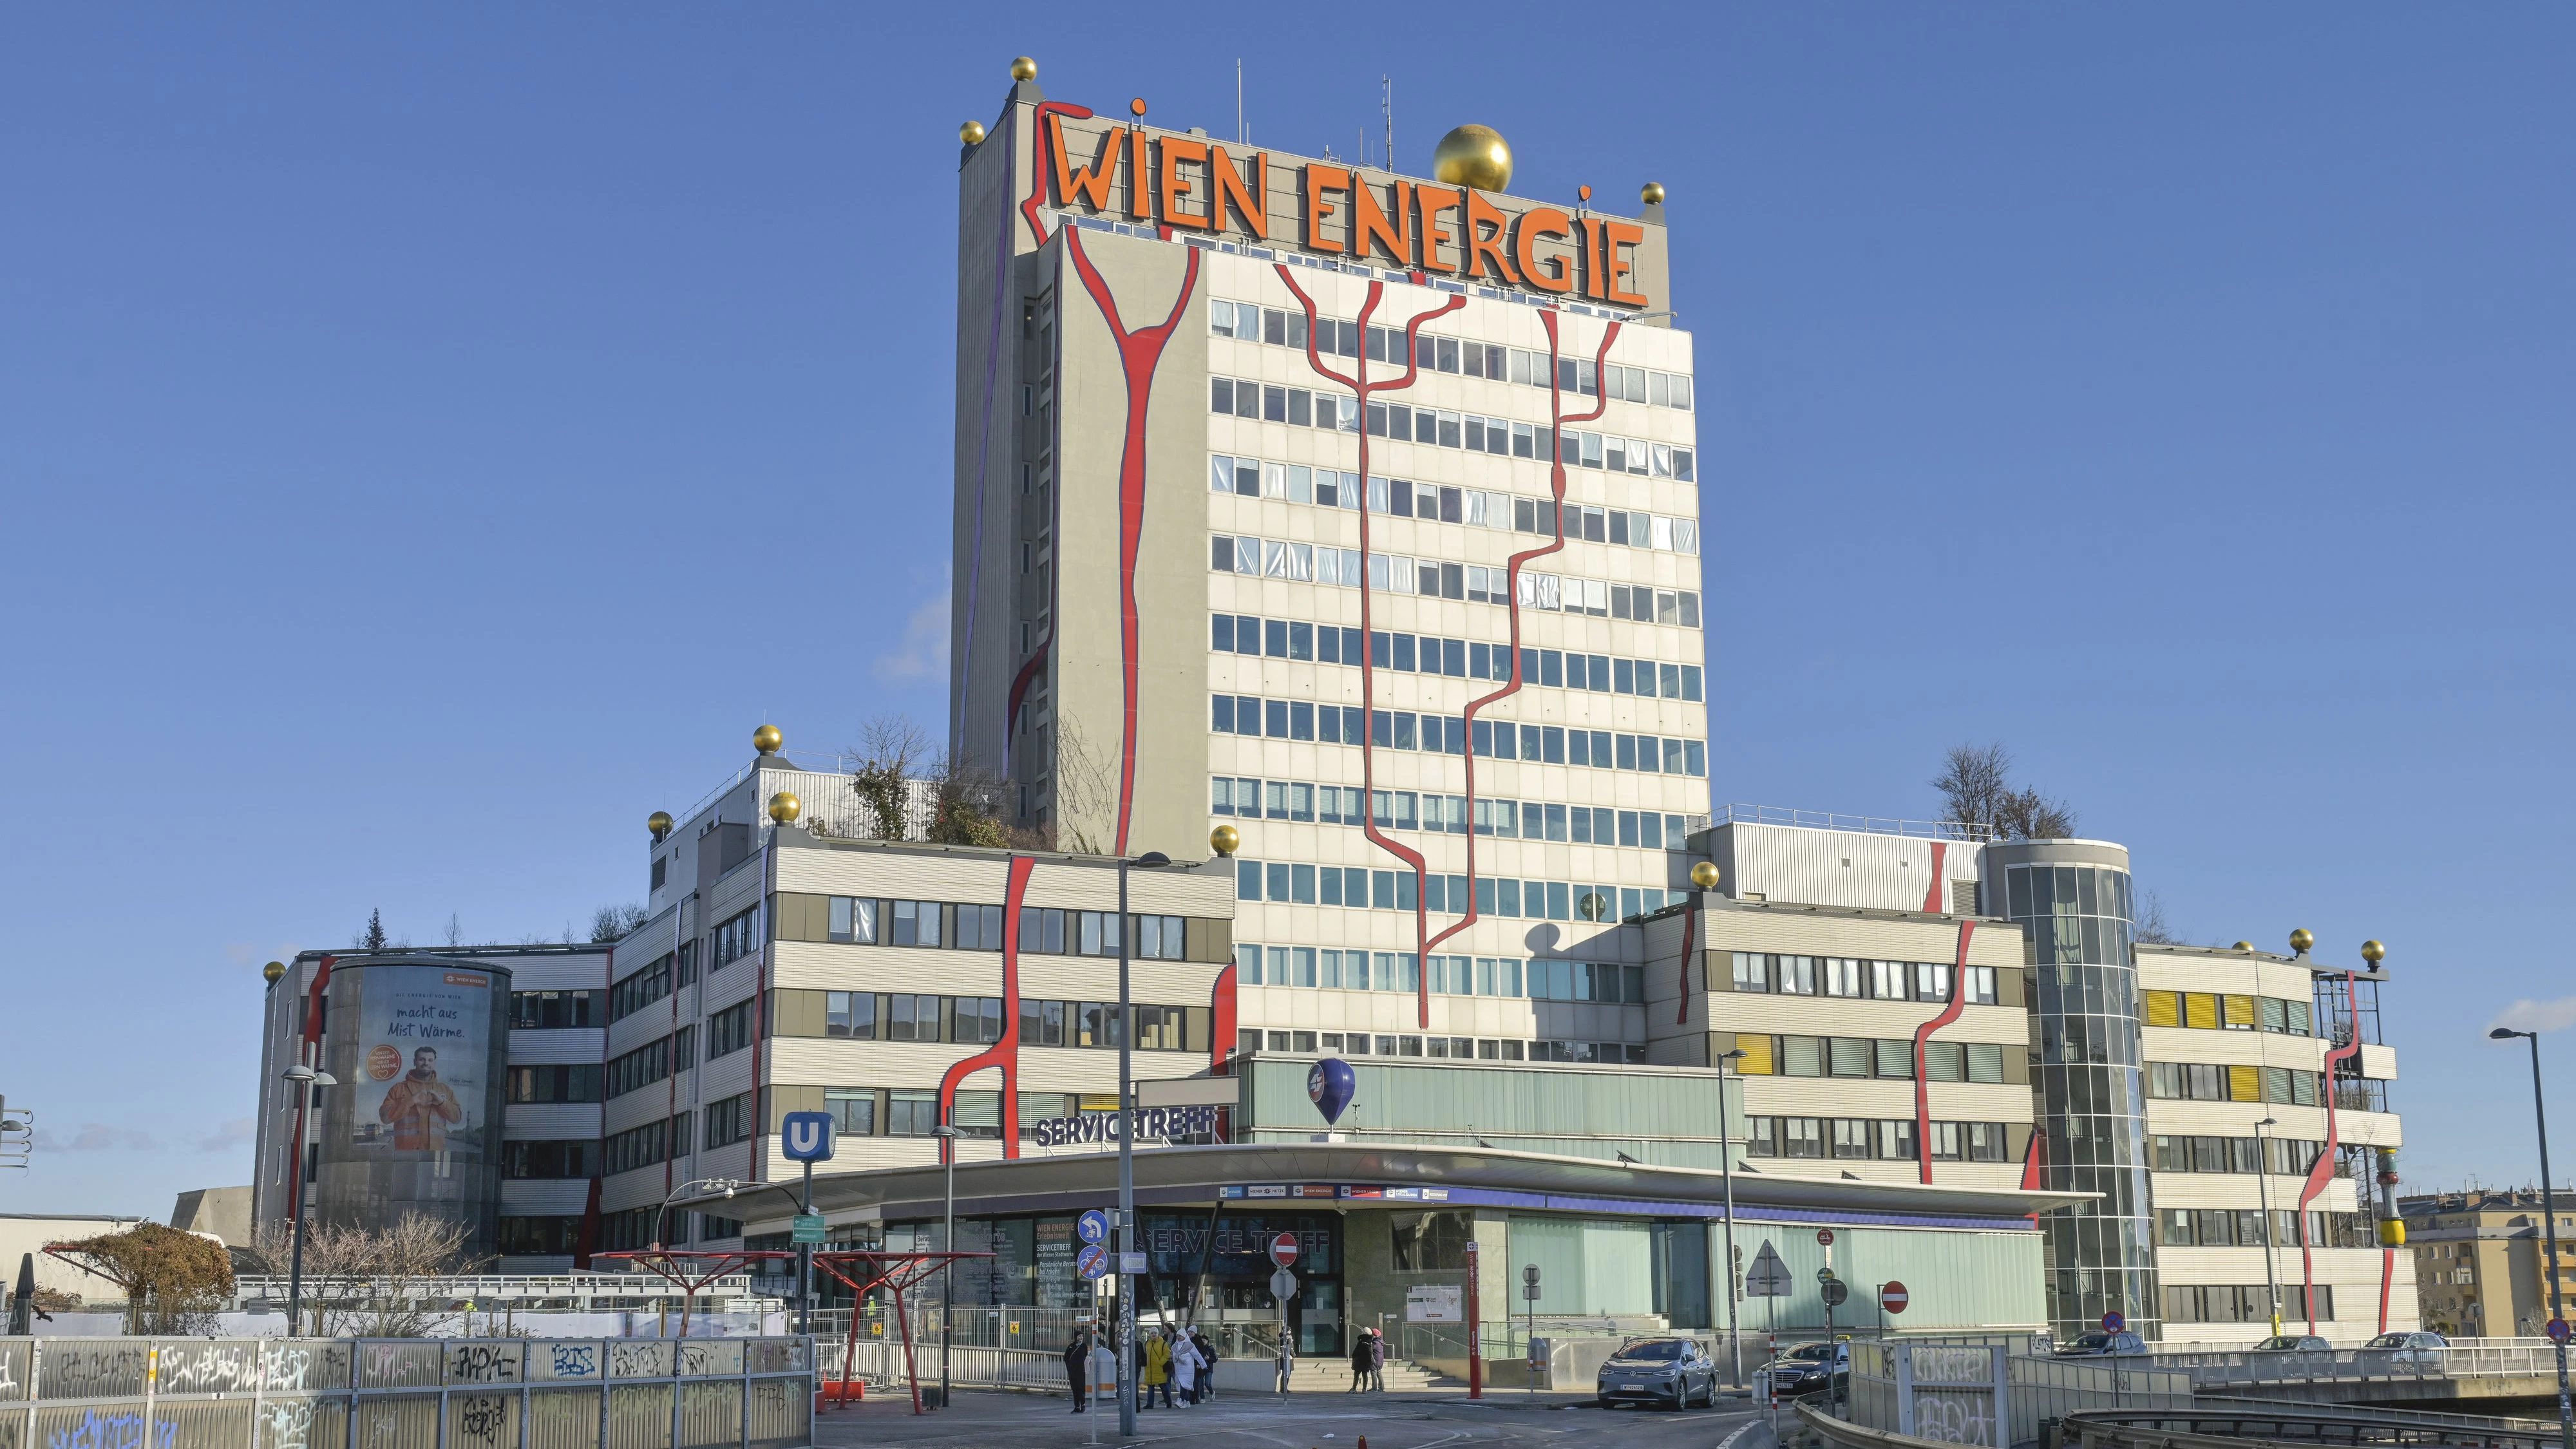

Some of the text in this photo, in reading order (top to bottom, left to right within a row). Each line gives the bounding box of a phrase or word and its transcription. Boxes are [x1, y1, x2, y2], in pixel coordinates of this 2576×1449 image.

[1048, 98, 1649, 307] WIEN ENERGIE
[397, 1005, 457, 1019] macht aus
[388, 1022, 465, 1037] Mist Wärme.
[791, 1122, 819, 1153] U
[1037, 1223, 1074, 1233] WIEN ENERGIE
[1251, 1231, 1329, 1255] TFF
[894, 1278, 918, 1287] Tikes
